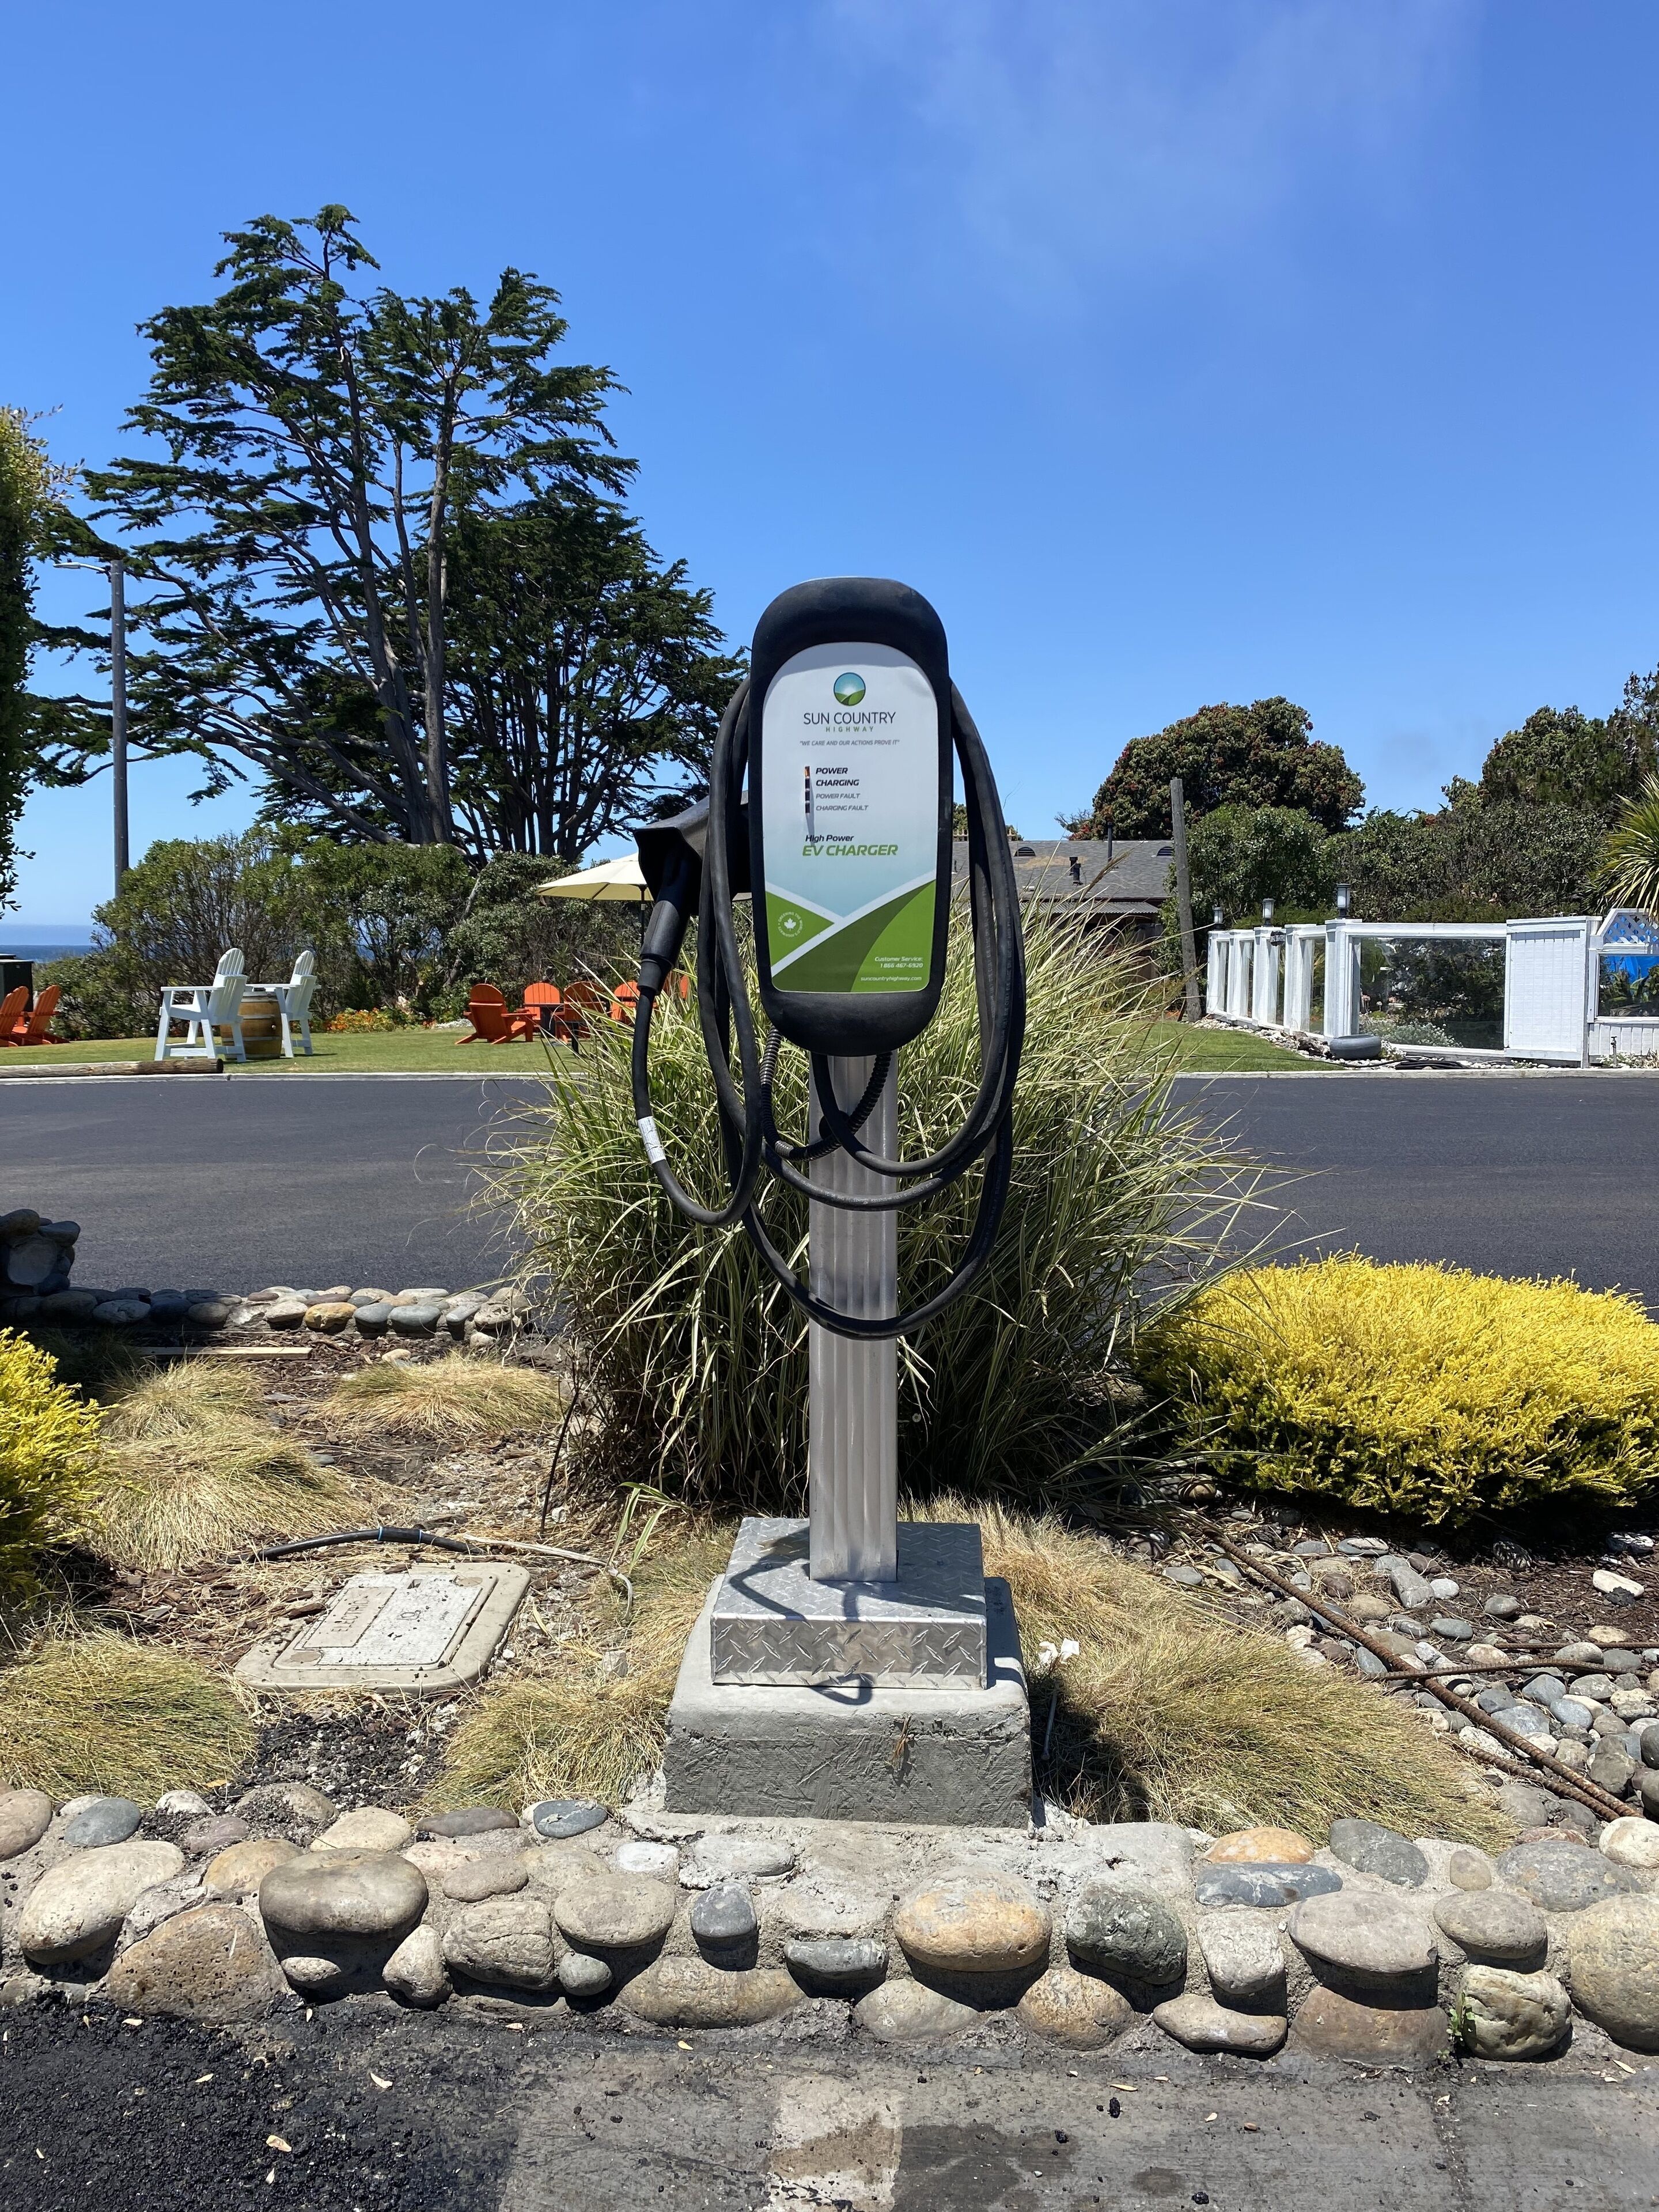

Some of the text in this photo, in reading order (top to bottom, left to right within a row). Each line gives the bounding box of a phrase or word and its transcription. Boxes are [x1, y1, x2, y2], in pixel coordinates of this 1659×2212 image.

[803, 711, 896, 725] SUN COUNTRY
[805, 834, 824, 843] High
[802, 844, 899, 857] EV CHARGER
